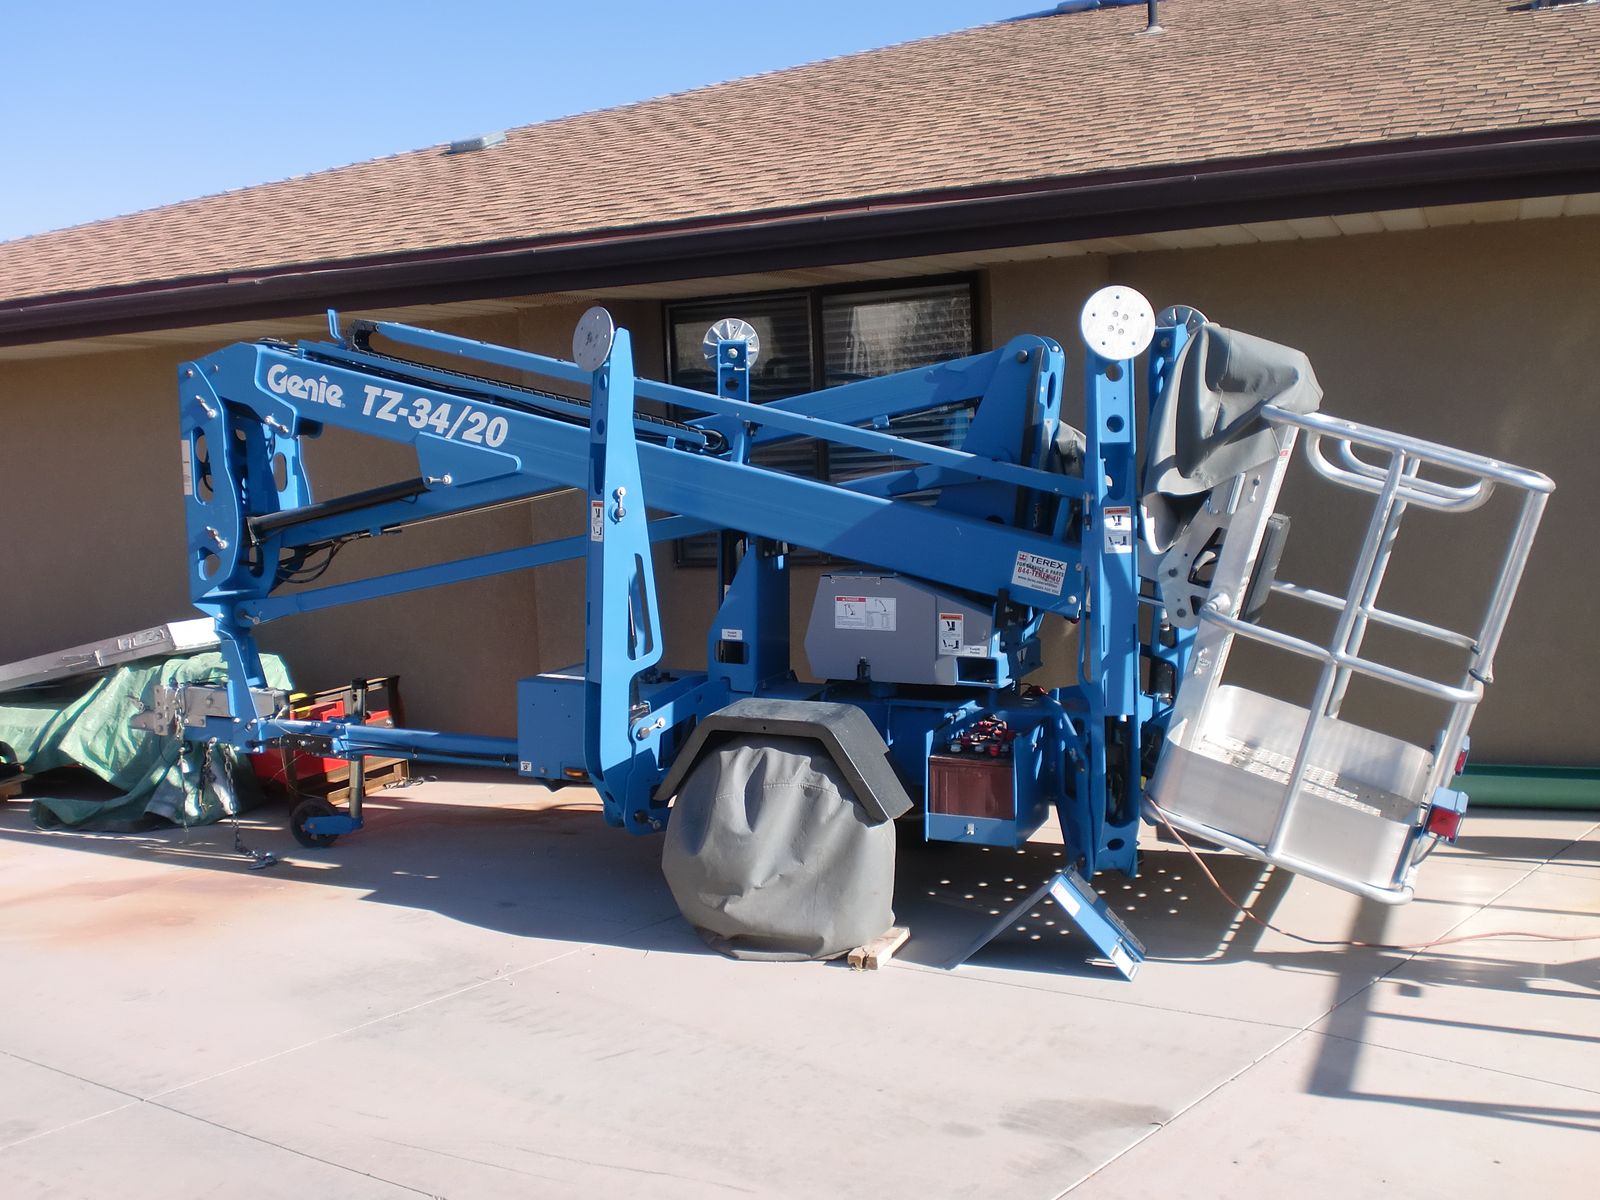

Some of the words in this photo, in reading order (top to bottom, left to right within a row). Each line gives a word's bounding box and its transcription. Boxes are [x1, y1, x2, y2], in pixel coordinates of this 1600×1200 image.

[267, 364, 343, 408] Genie
[362, 384, 509, 448] TZ-34/20
[1030, 556, 1064, 570] TEREX
